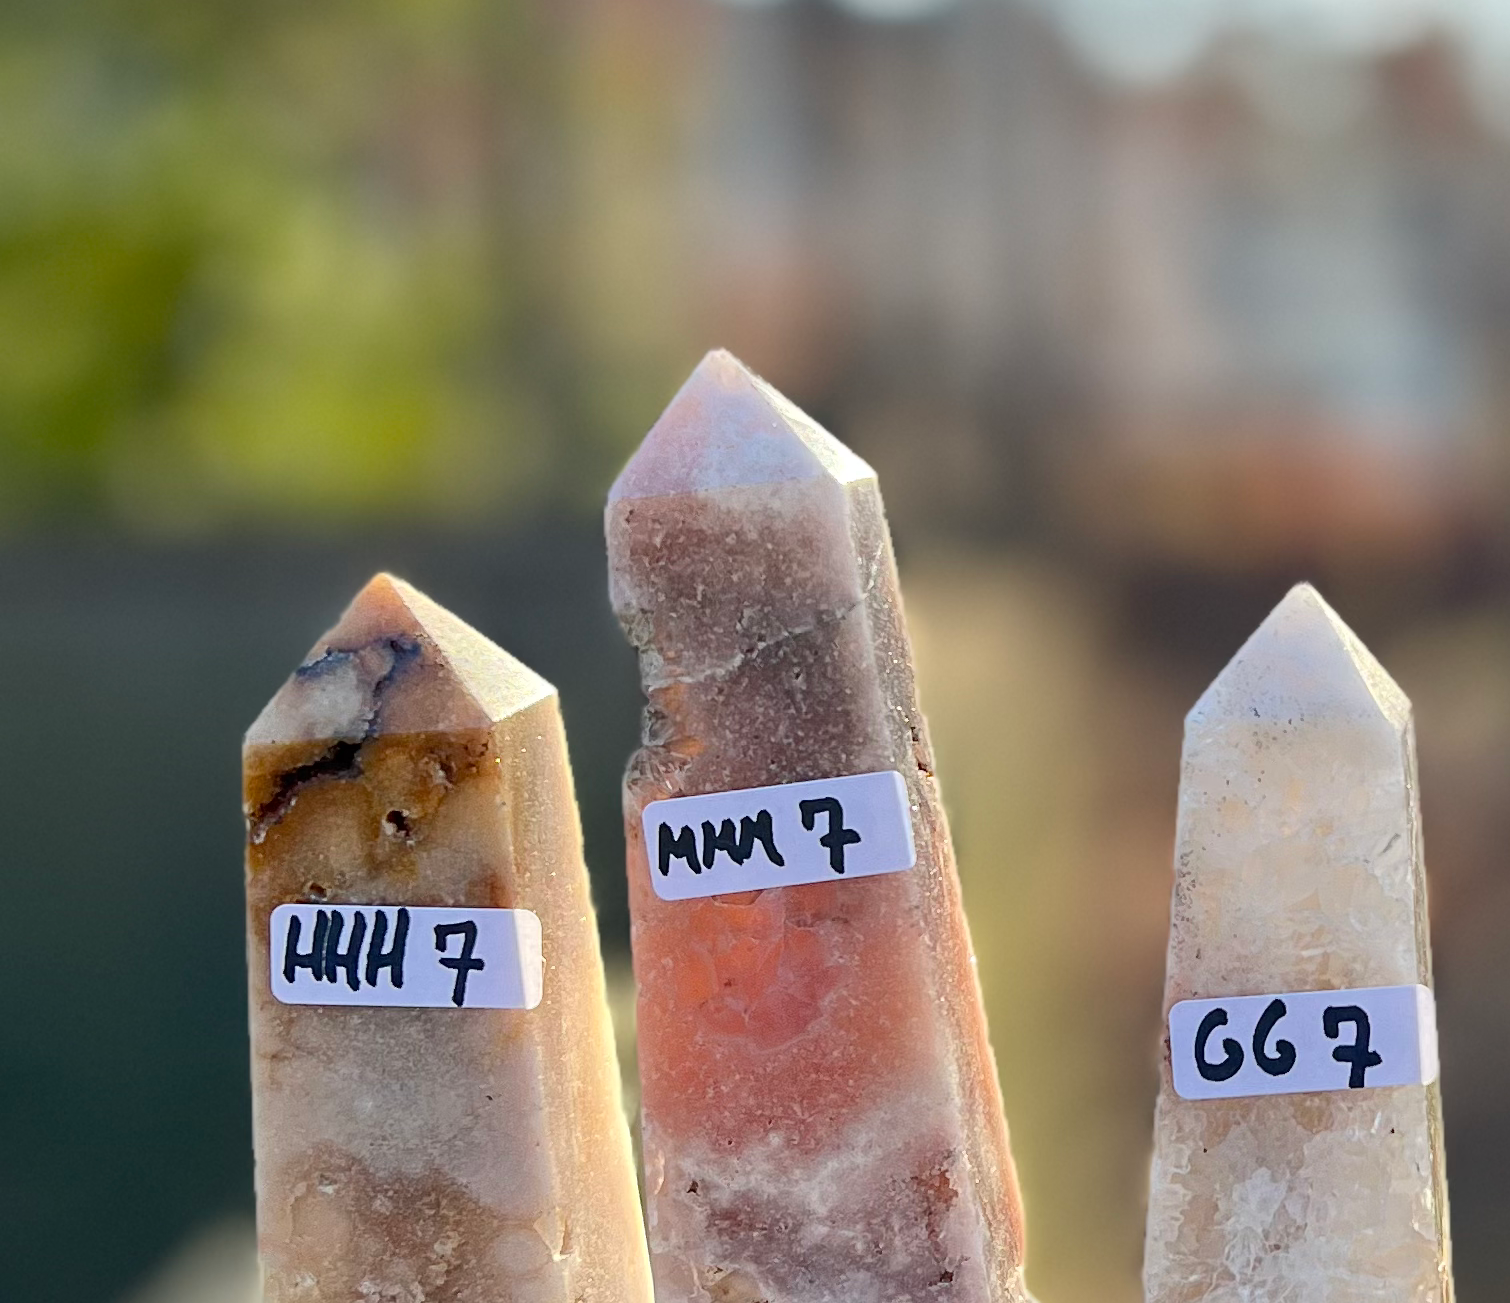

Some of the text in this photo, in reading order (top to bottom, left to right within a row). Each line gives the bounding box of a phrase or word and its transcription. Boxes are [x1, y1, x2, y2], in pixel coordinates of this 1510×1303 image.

[798, 796, 862, 875] 7
[282, 907, 485, 1008] HHH 7
[1322, 1005, 1383, 1090] 7
